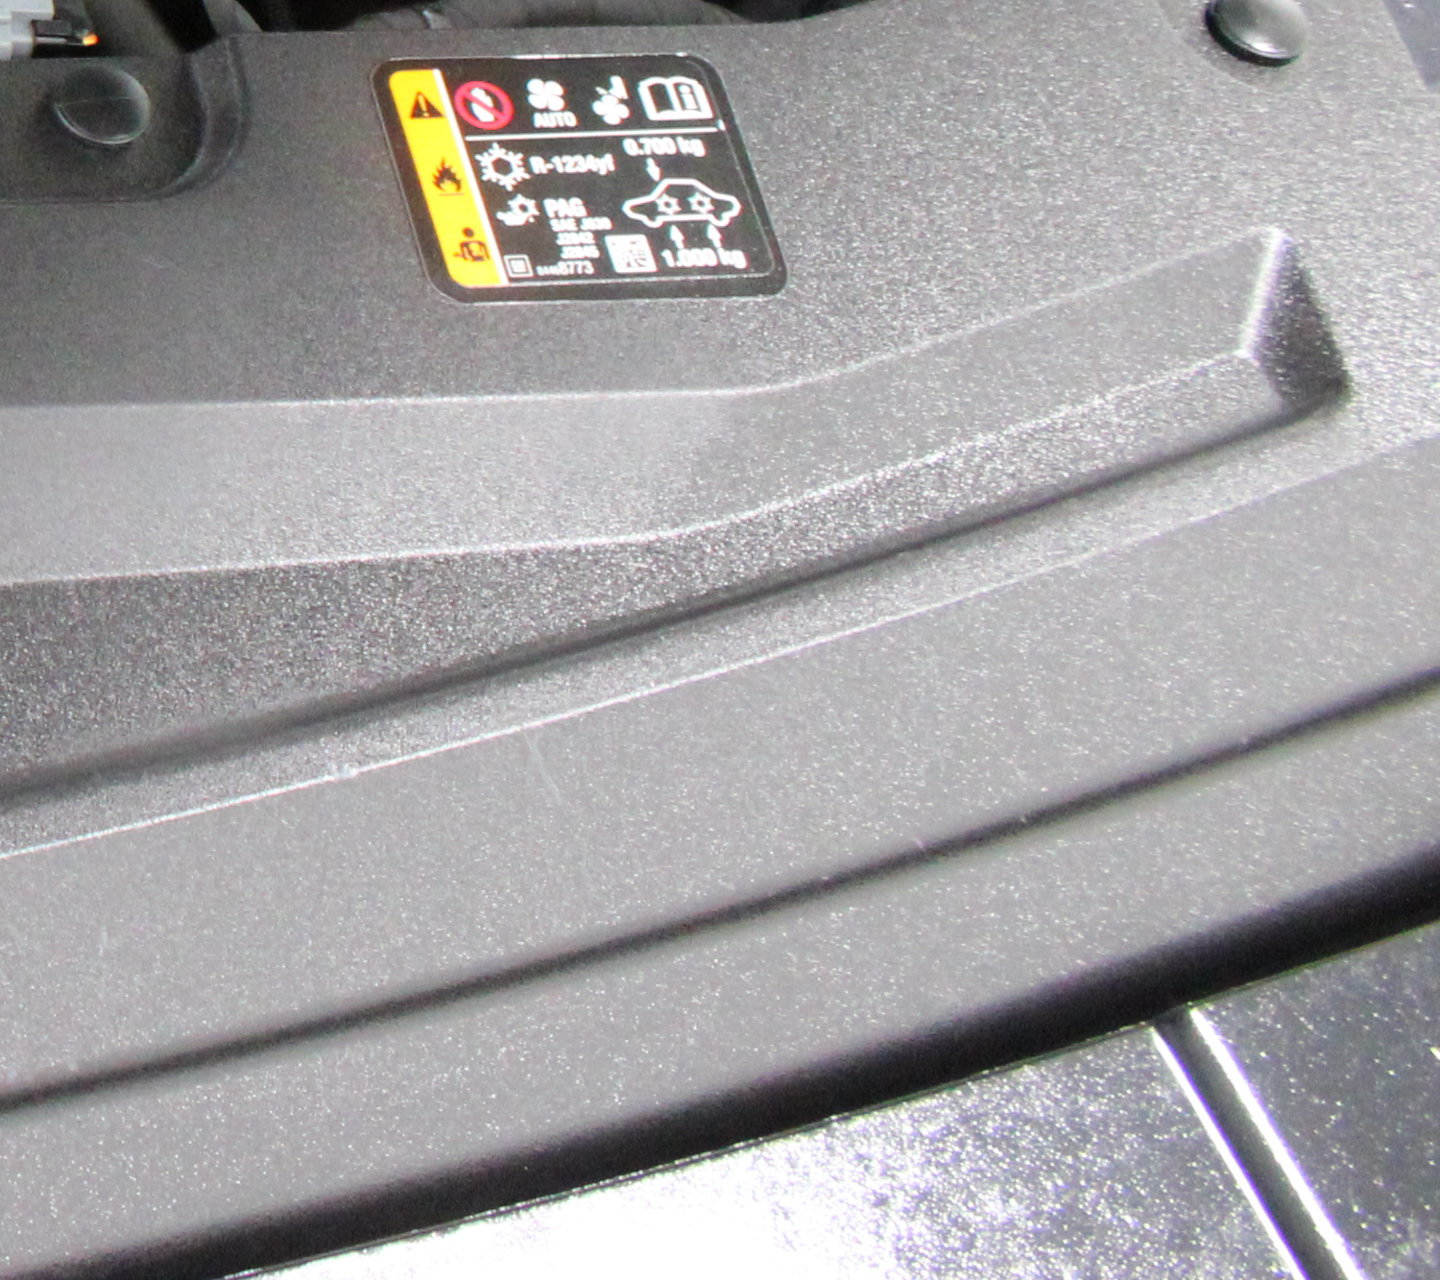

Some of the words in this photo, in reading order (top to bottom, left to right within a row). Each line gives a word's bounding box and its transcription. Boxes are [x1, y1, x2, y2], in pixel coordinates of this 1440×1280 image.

[533, 111, 577, 129] AUTO
[622, 136, 677, 157] 0.700
[676, 136, 706, 158] kg
[529, 153, 616, 176] R-1234yf
[543, 197, 588, 218] PAG
[661, 247, 718, 268] 1.000
[717, 247, 748, 269] kg
